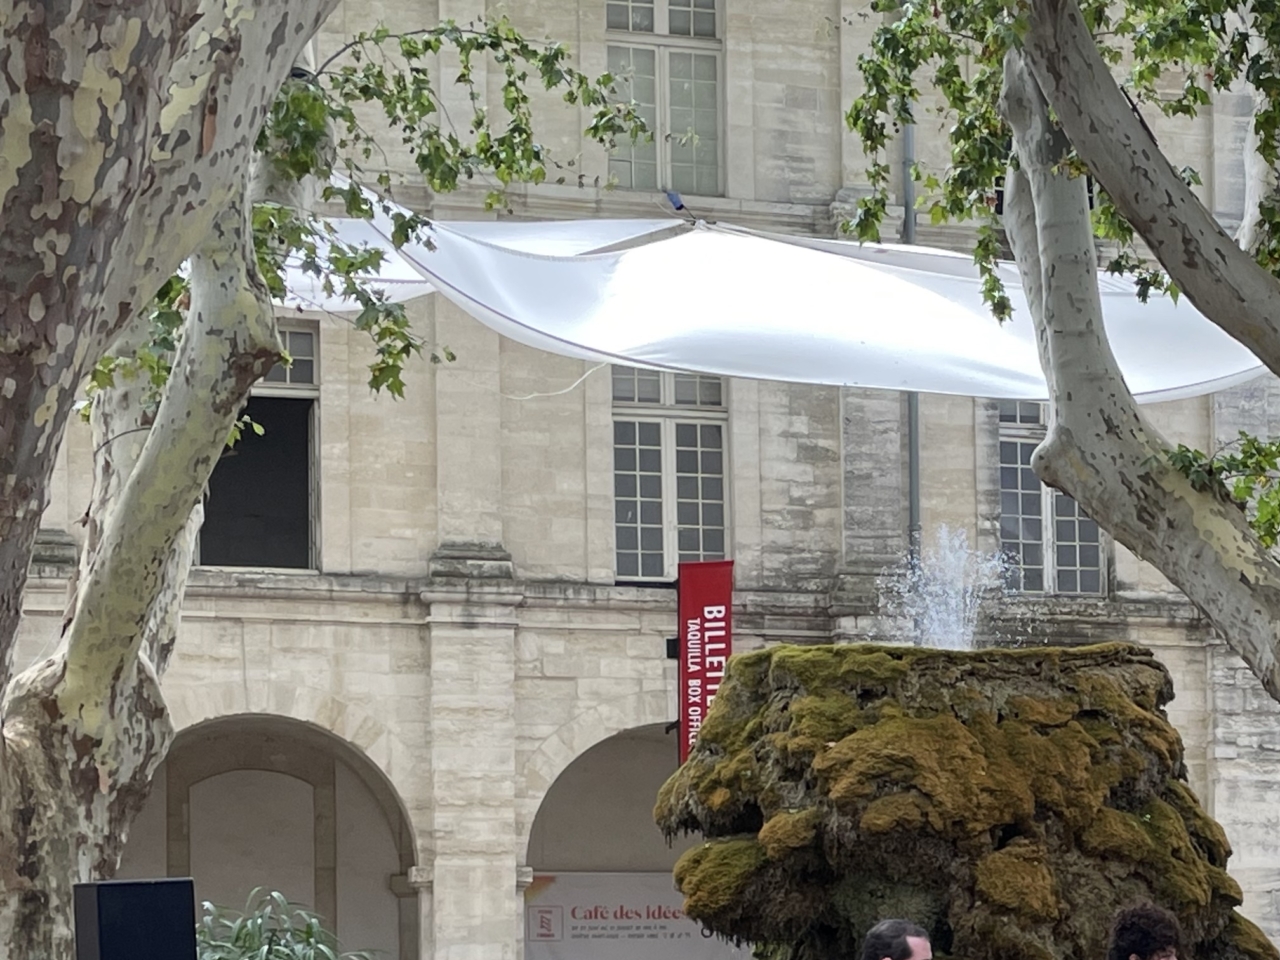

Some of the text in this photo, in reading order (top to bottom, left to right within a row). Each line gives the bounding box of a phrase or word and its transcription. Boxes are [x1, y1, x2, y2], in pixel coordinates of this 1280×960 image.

[687, 617, 701, 673] TAQUILLA
[688, 679, 701, 703] BOX
[570, 904, 609, 920] Café
[613, 904, 642, 920] des
